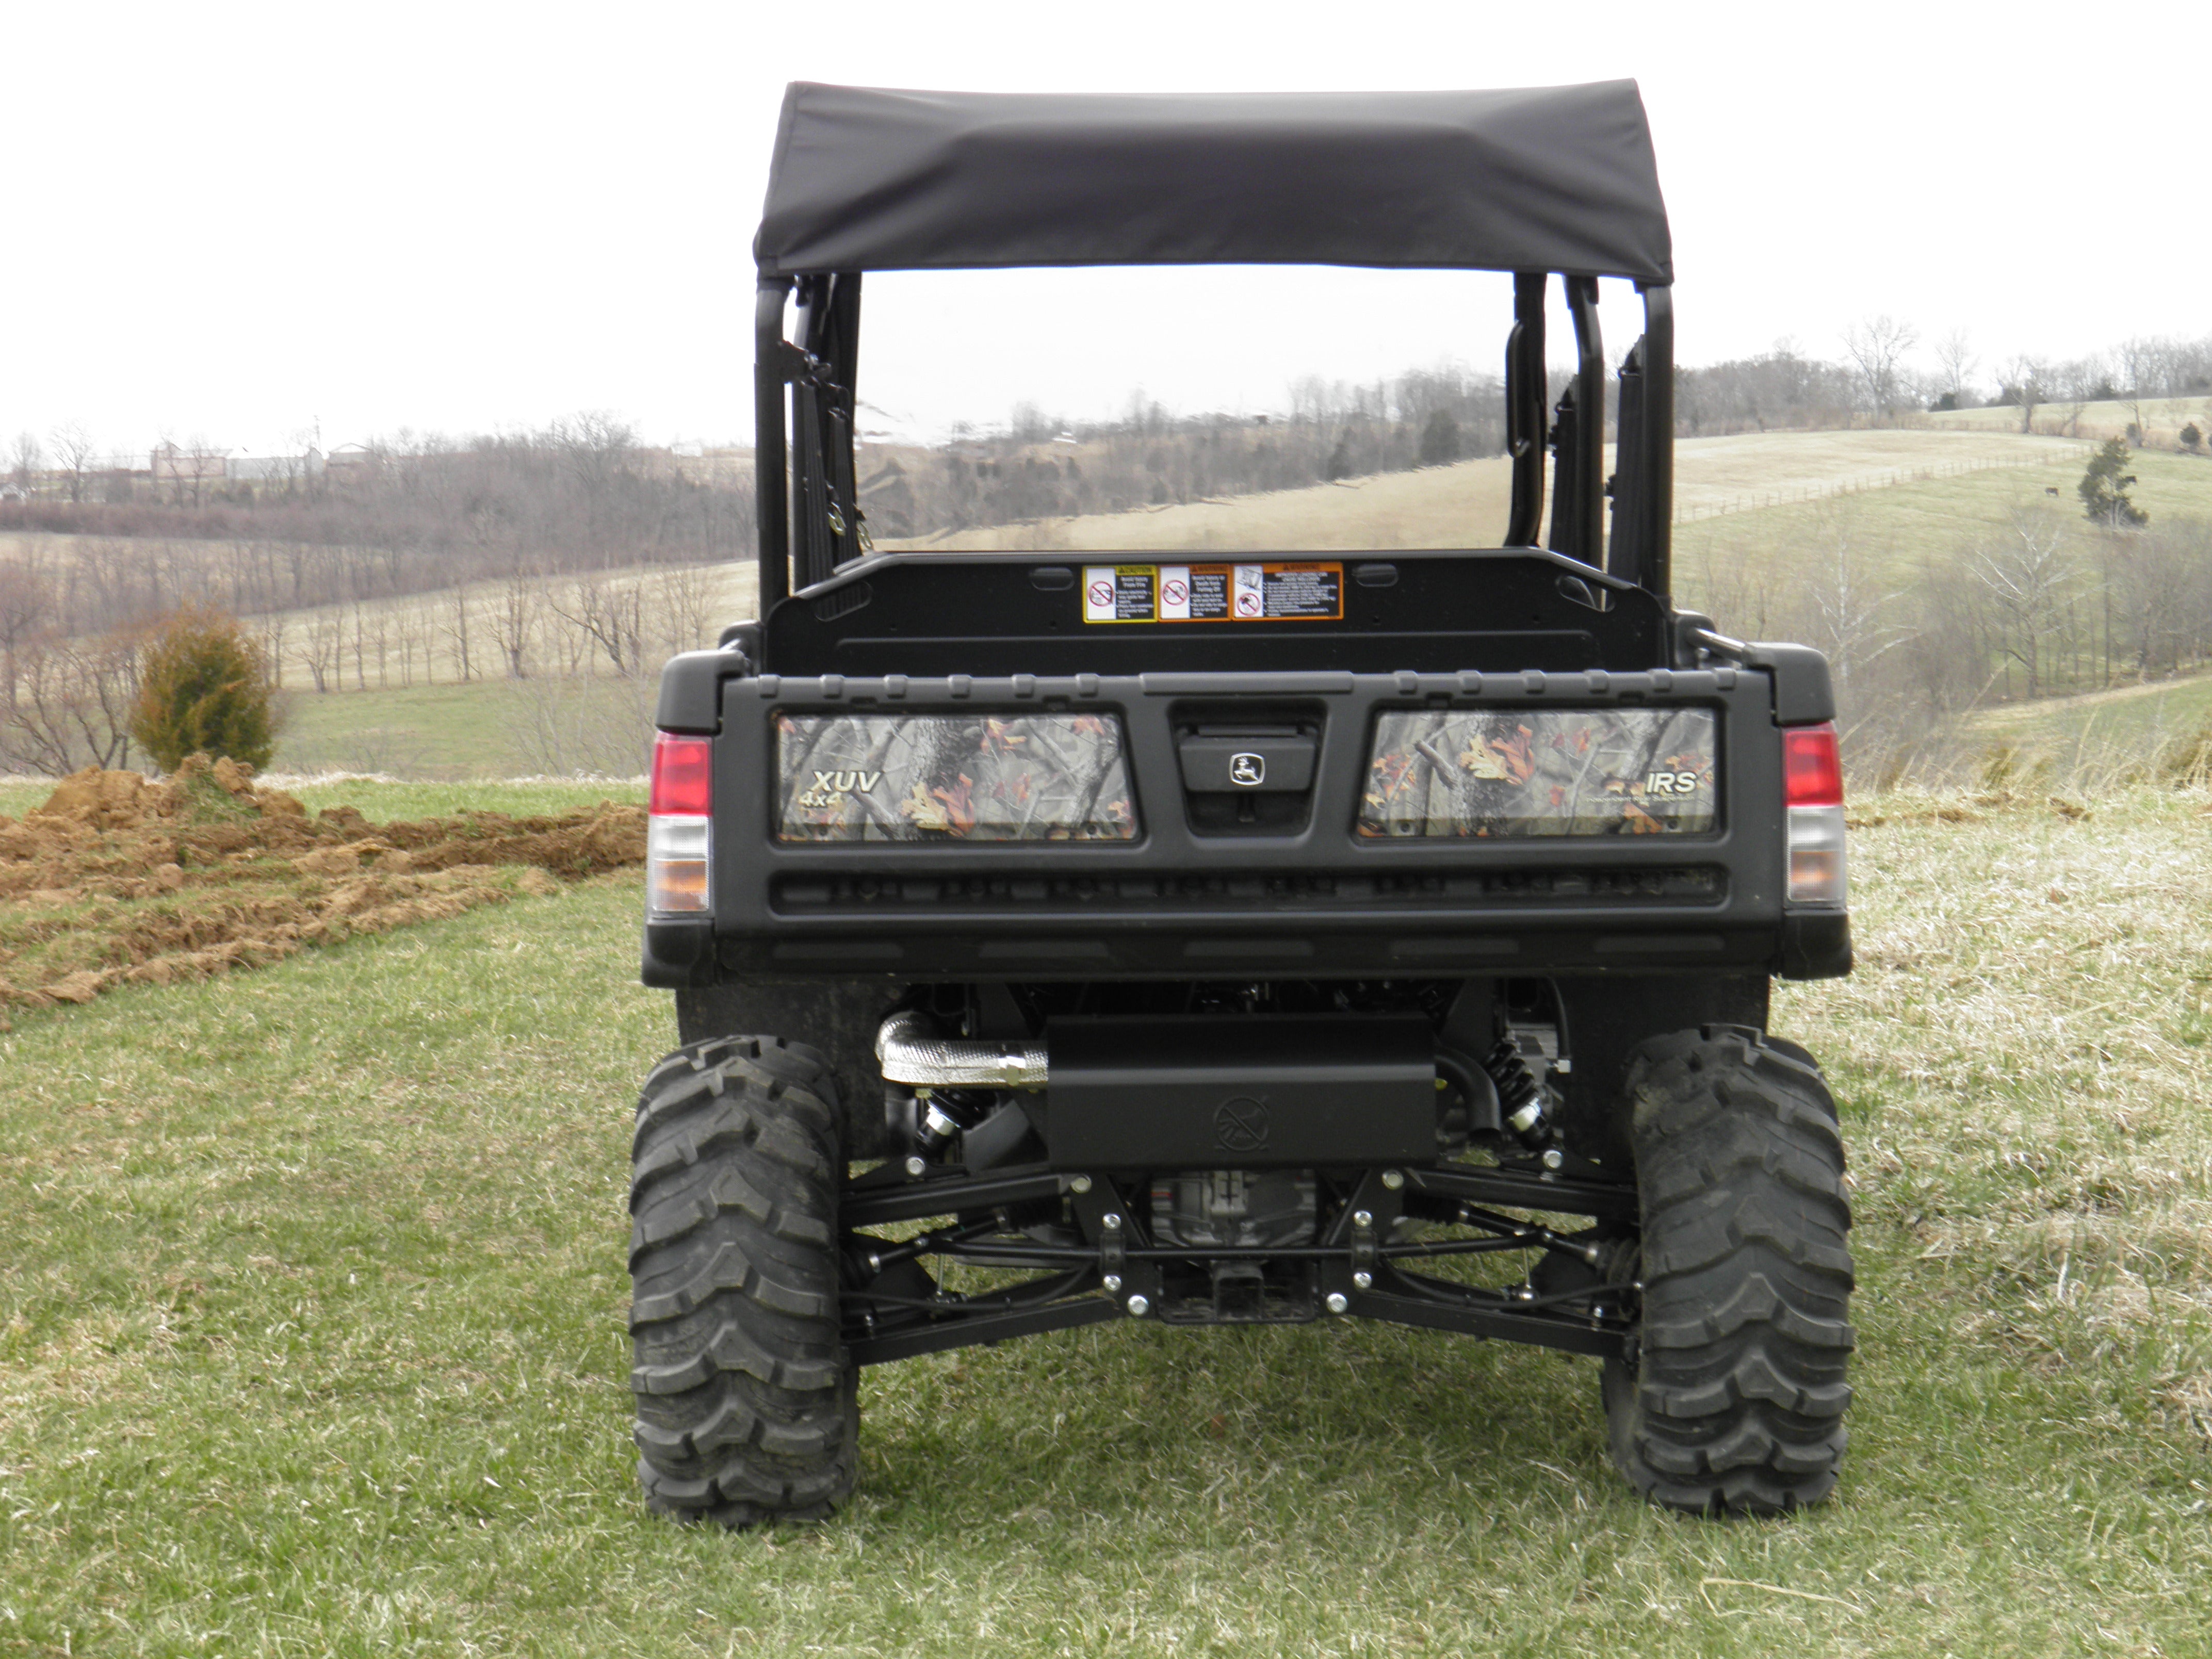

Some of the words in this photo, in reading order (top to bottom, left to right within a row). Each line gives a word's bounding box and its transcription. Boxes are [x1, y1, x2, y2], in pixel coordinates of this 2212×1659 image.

[810, 771, 882, 792] XUV
[1646, 771, 1697, 793] IRS
[800, 790, 842, 807] 4x4
